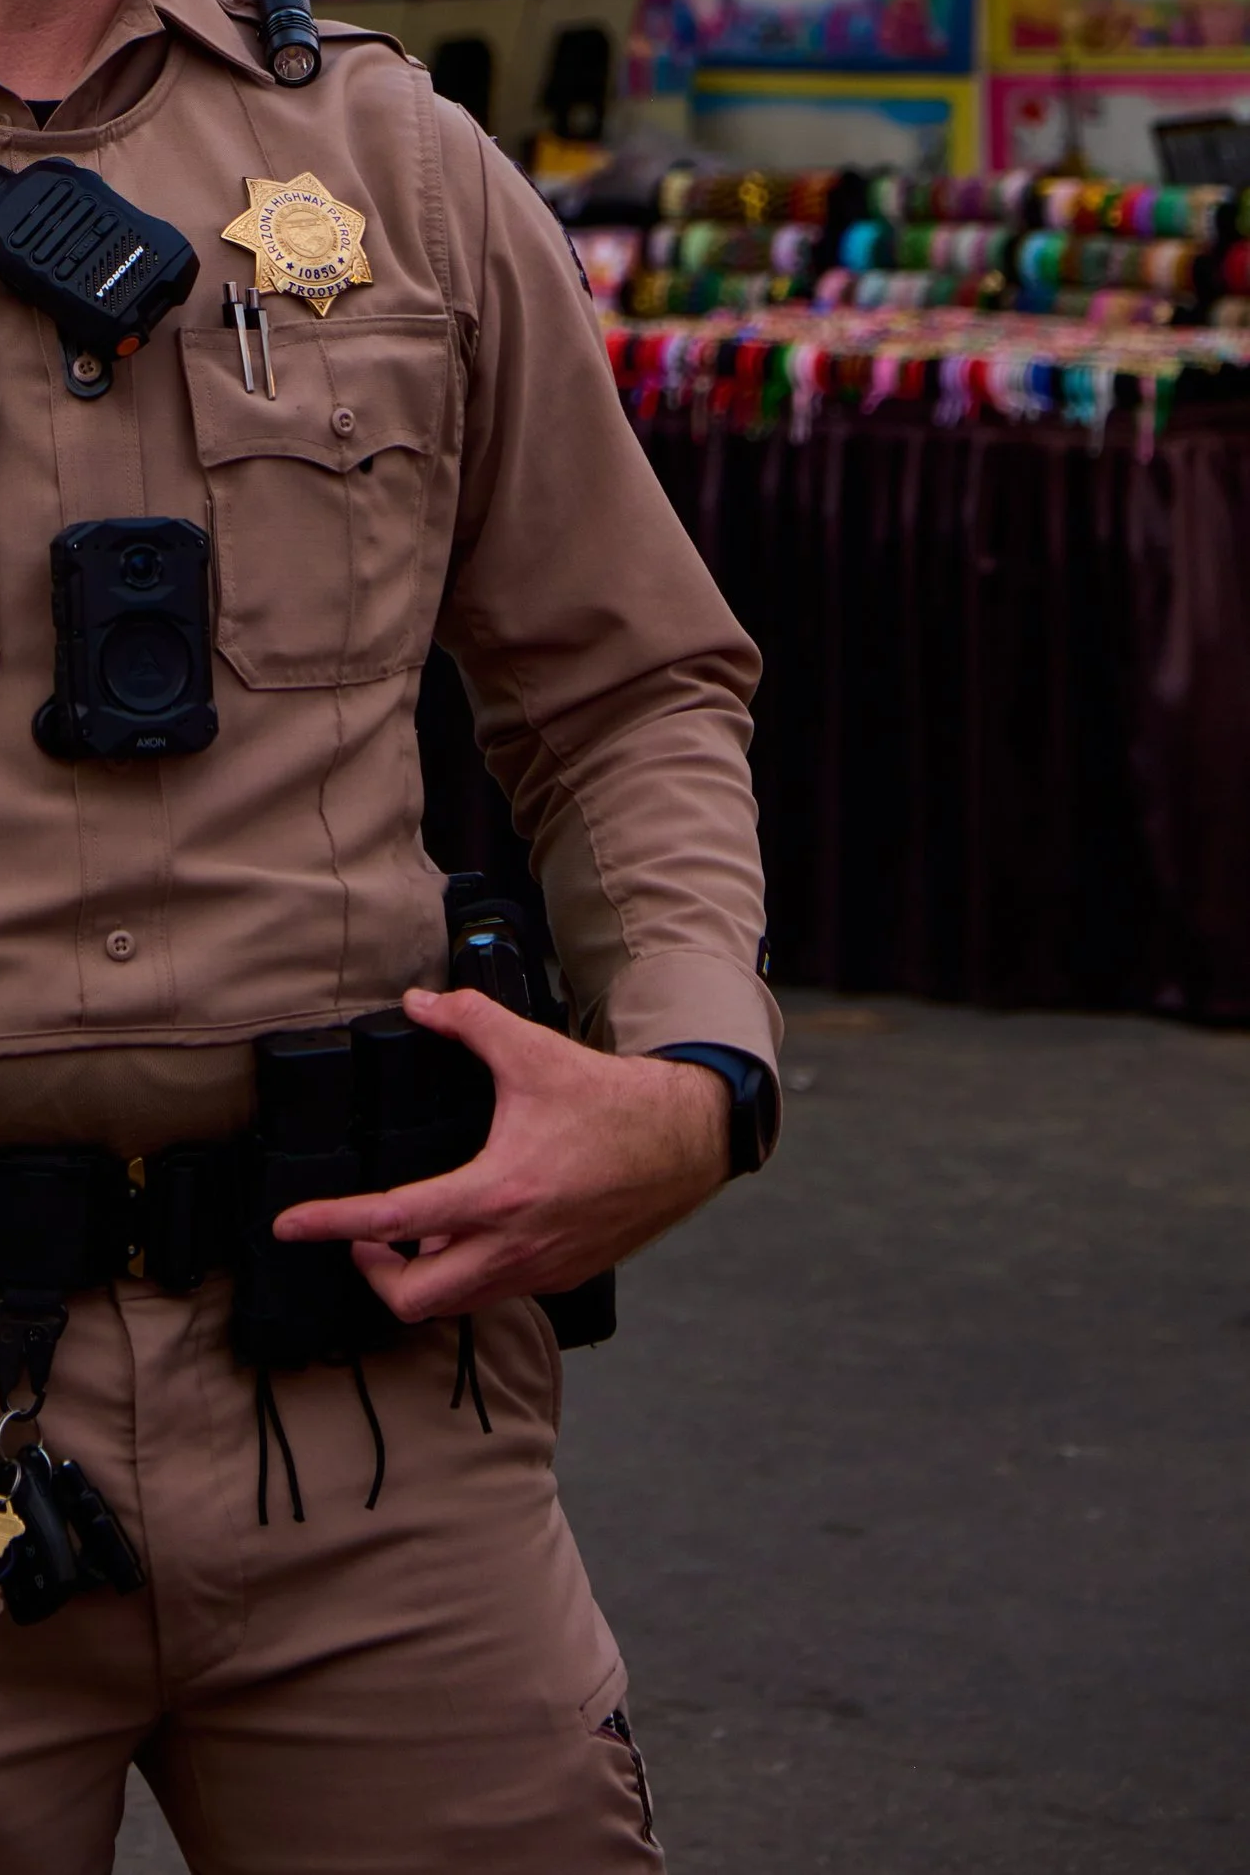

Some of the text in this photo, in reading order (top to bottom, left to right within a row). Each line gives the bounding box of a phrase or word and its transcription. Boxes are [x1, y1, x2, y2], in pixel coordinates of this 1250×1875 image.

[271, 192, 326, 208] HIGHWAY
[259, 207, 284, 261] ARIZONA
[327, 207, 351, 252] PATROL
[96, 245, 144, 297] MOTOROLA
[298, 264, 337, 280] 10850
[287, 276, 351, 297] TROOPER
[136, 737, 166, 748] AXON
